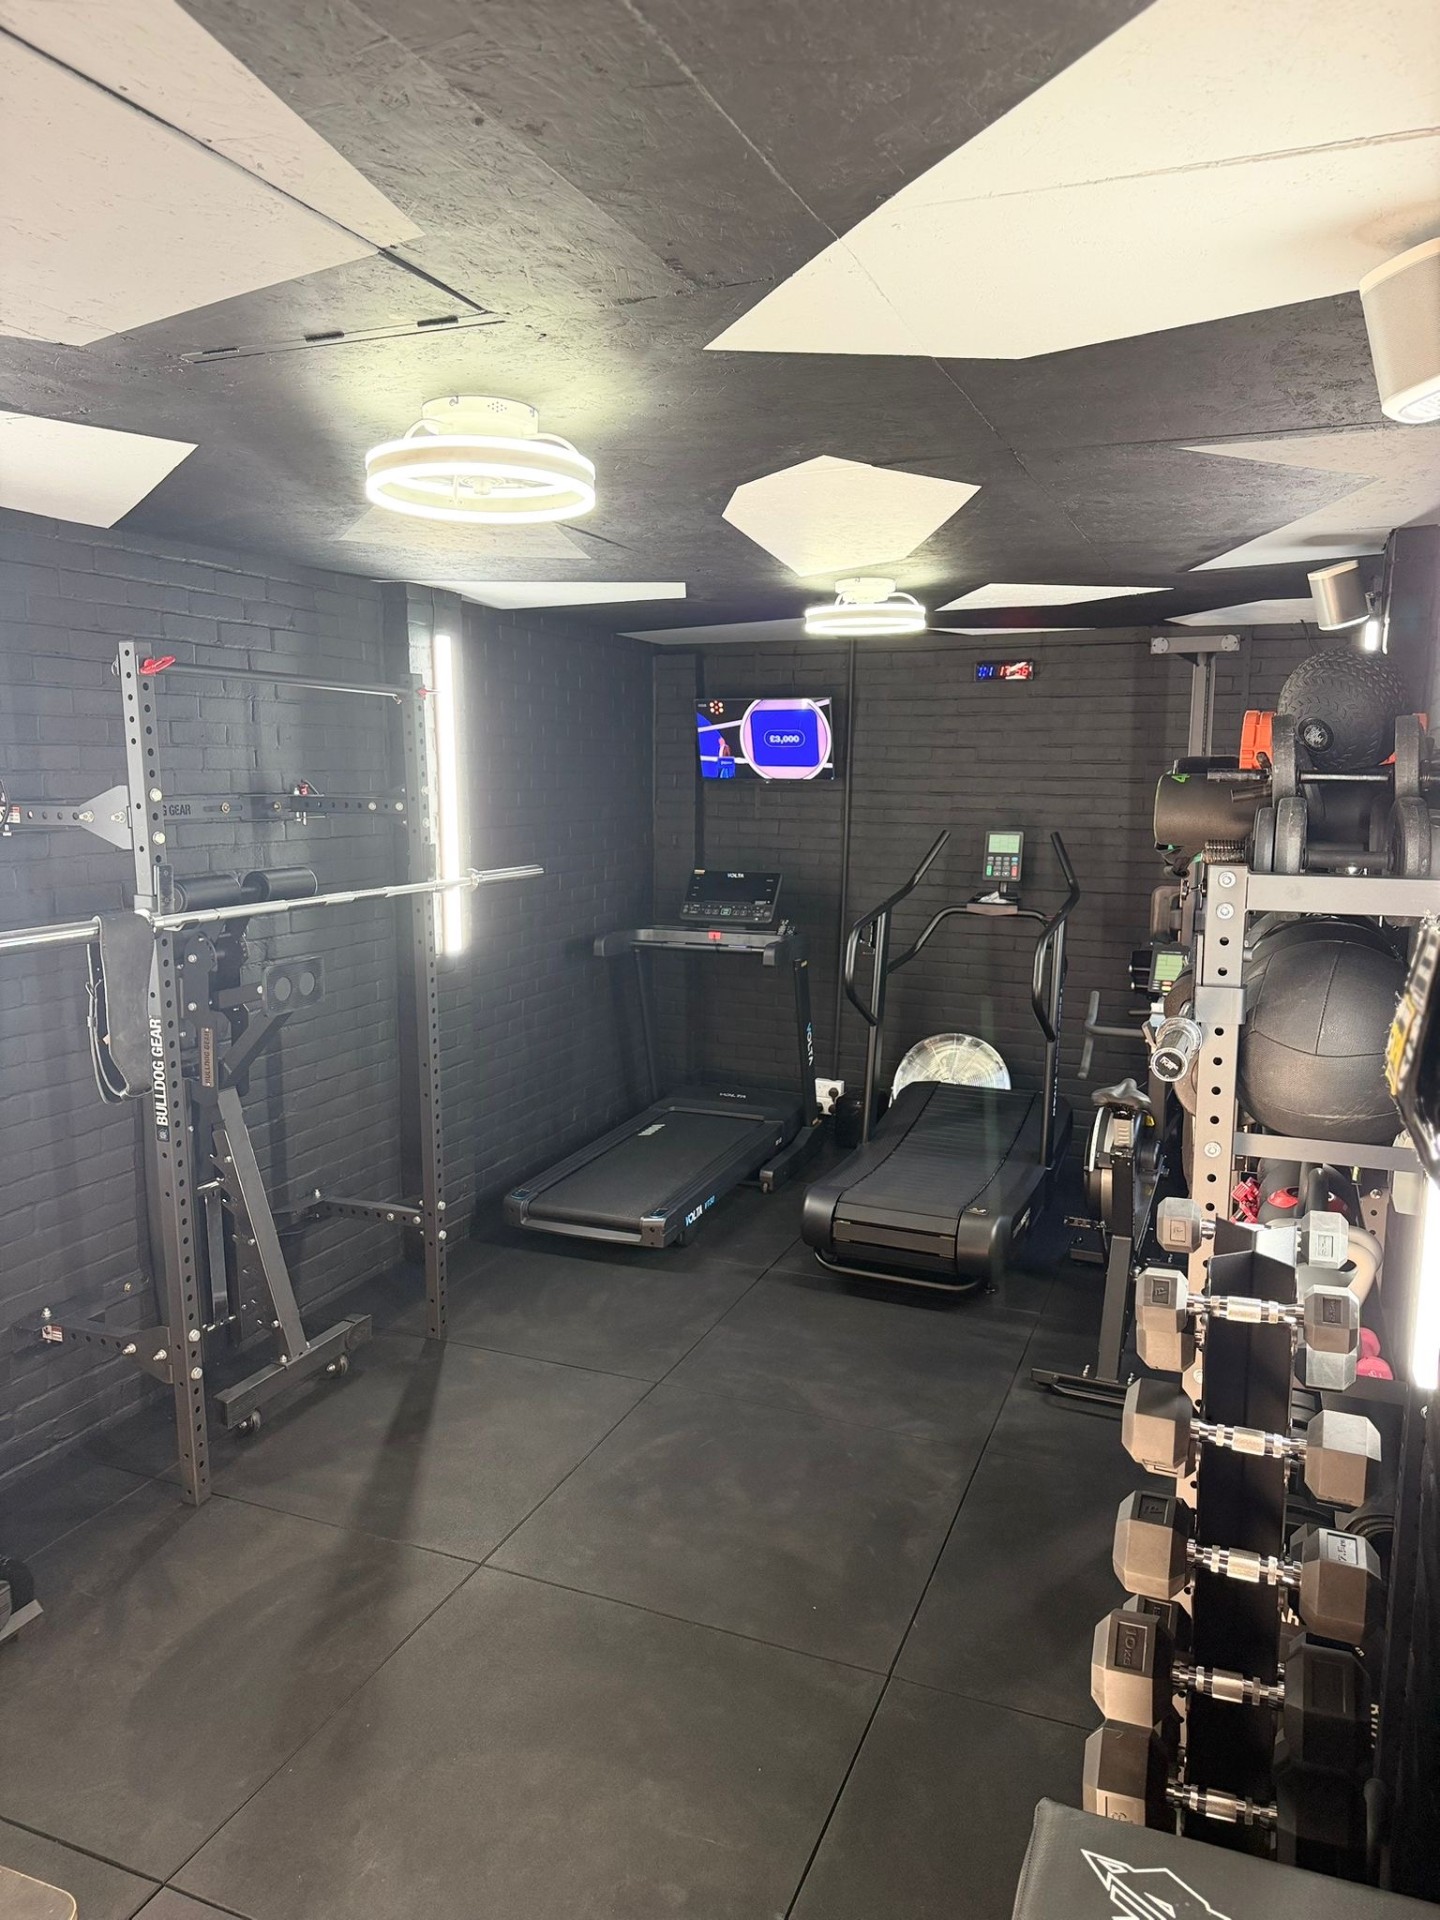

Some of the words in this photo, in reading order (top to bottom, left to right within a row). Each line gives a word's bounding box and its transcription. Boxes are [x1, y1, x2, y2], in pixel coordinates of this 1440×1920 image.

[769, 735, 800, 745] £3,000
[168, 804, 192, 816] GEAR
[149, 1018, 164, 1058] GEAR
[152, 1060, 169, 1127] BULLDOG
[685, 1204, 703, 1227] VOLTA
